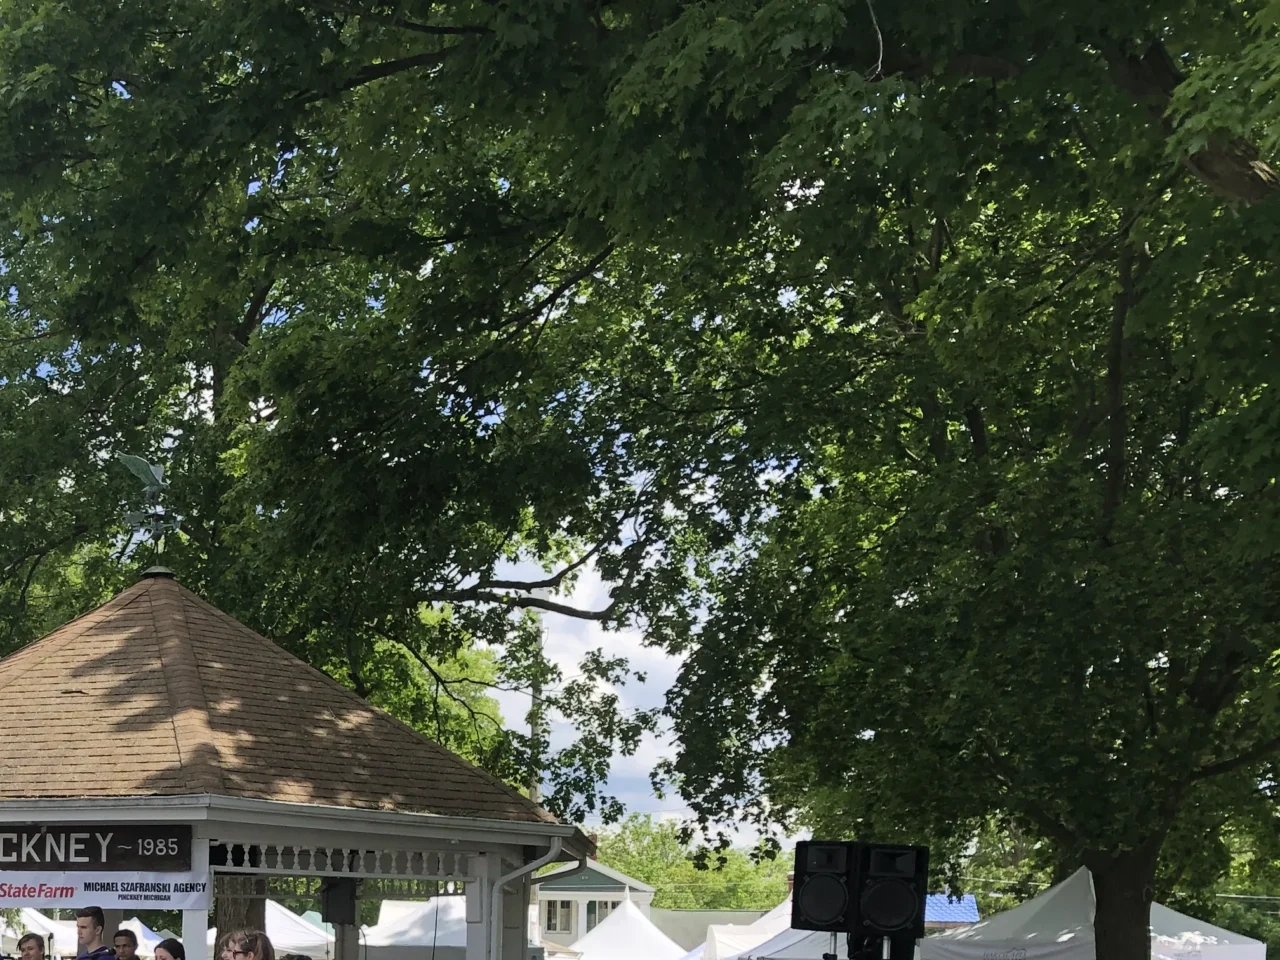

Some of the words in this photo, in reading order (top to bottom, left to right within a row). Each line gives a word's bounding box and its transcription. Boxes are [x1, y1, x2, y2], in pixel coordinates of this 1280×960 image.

[137, 838, 179, 856] 1985
[83, 882, 119, 892] MICHAEL
[120, 882, 171, 893] SZAFRANSKI
[173, 882, 207, 893] AGENCY
[143, 894, 172, 902] MICHIGAN
